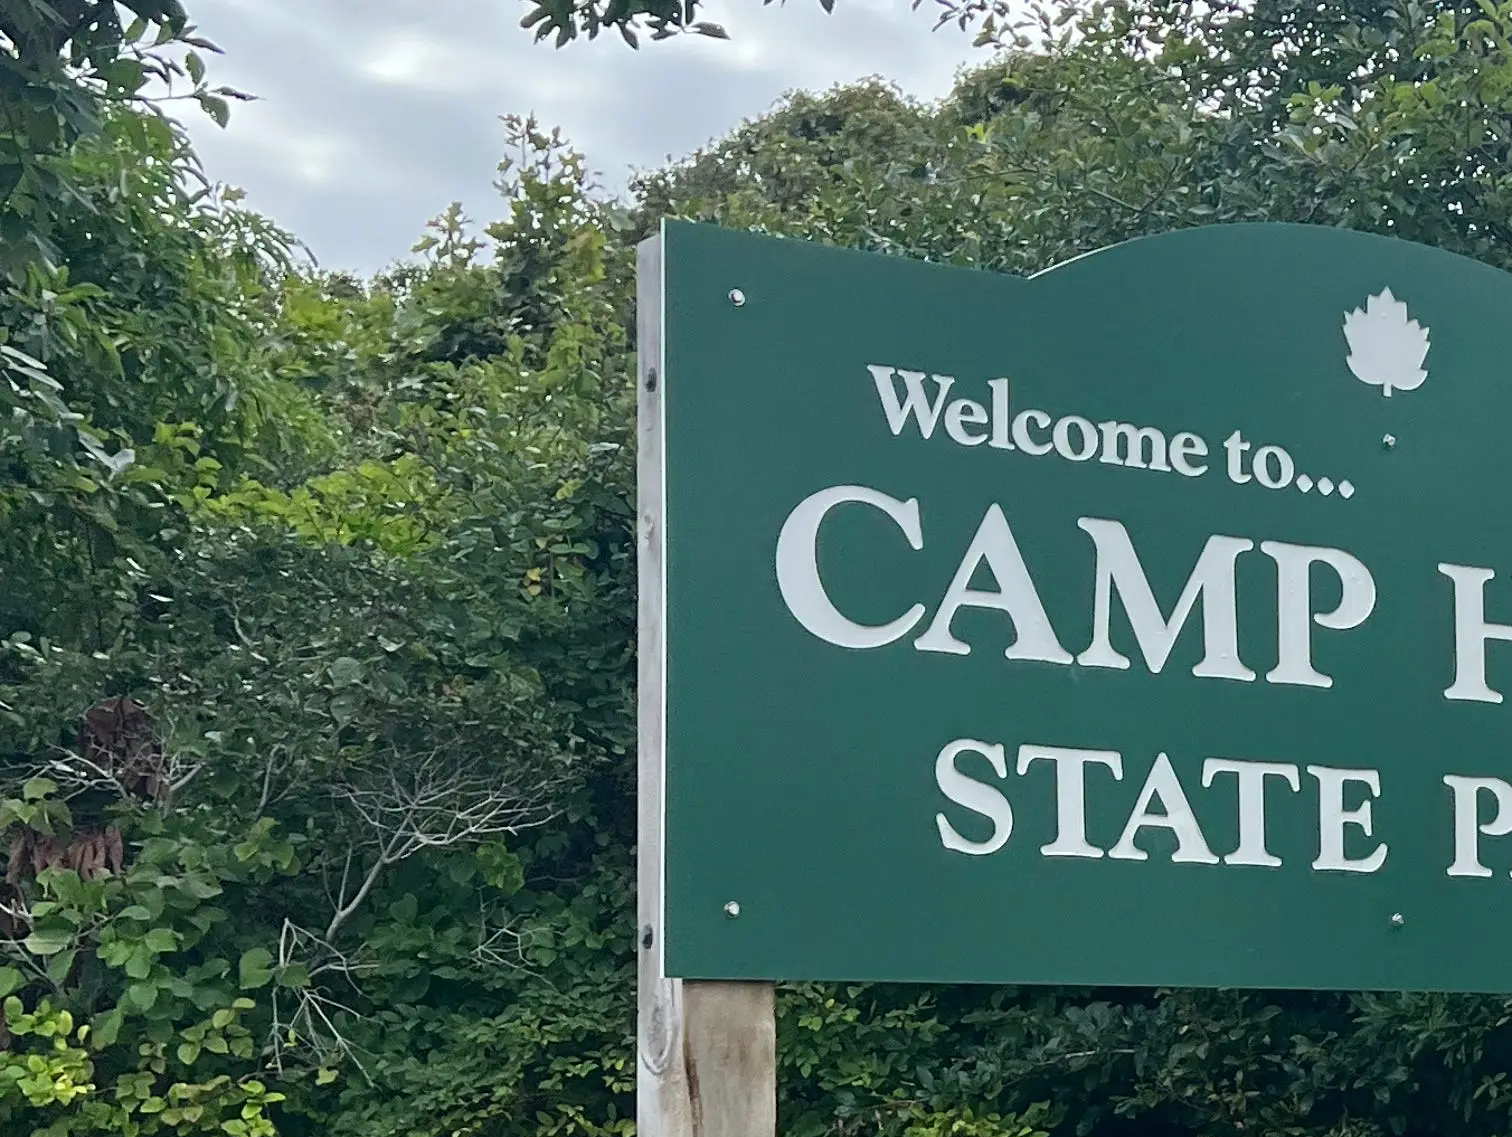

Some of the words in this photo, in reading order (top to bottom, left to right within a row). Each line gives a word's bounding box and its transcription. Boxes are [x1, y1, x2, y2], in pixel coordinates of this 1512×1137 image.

[866, 364, 1209, 477] Welcome
[1223, 430, 1356, 499] to...
[775, 485, 1376, 688] CAMP
[935, 738, 1388, 874] STATE
